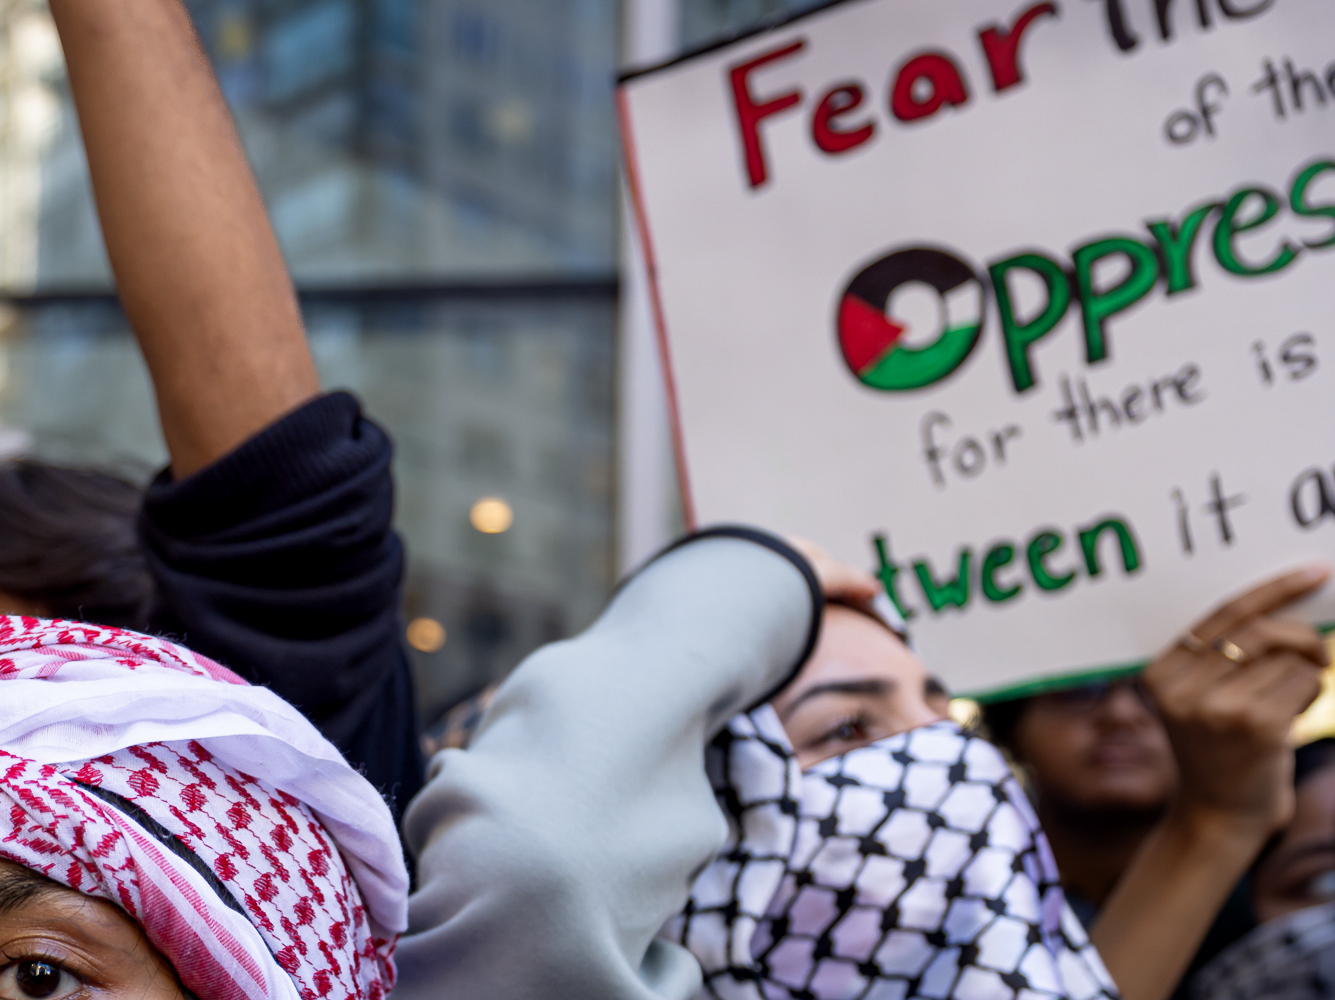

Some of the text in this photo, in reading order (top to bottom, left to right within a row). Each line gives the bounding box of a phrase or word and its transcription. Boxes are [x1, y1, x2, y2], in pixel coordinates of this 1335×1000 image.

[726, 2, 1059, 192] Fear
[1163, 72, 1229, 145] of
[919, 333, 1317, 487] for there is
[1170, 470, 1247, 556] it
